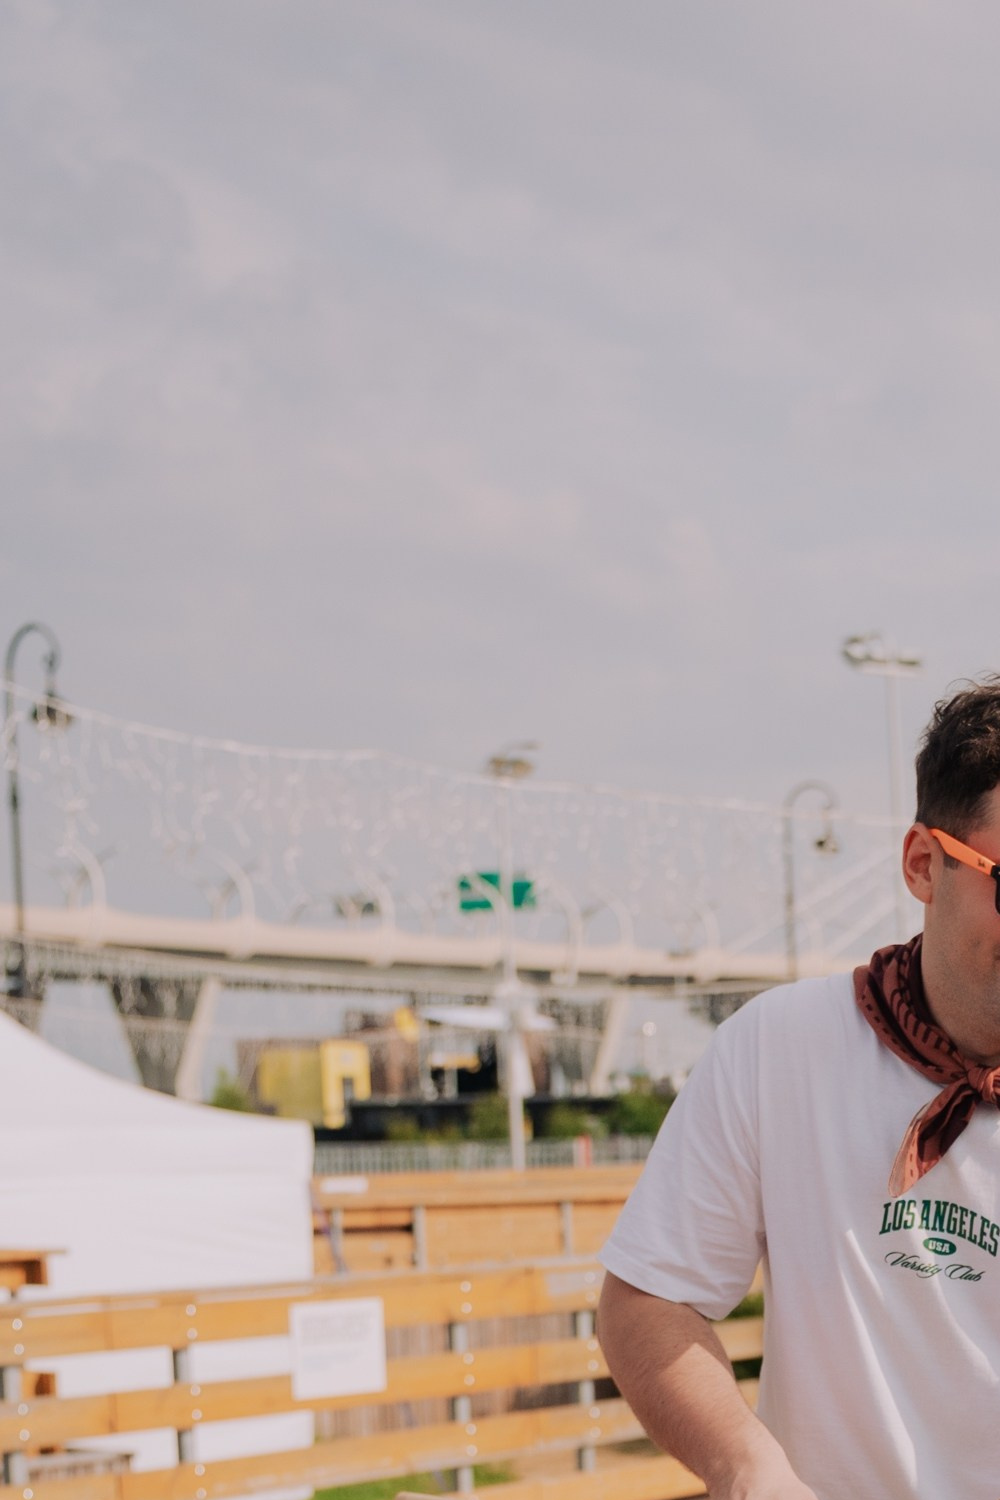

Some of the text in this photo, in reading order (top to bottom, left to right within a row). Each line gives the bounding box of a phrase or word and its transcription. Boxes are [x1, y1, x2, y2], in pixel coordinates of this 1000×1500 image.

[879, 1199, 1000, 1257] LOS ANGELES
[928, 1240, 950, 1253] USA
[884, 1251, 986, 1282] Varsity Club
